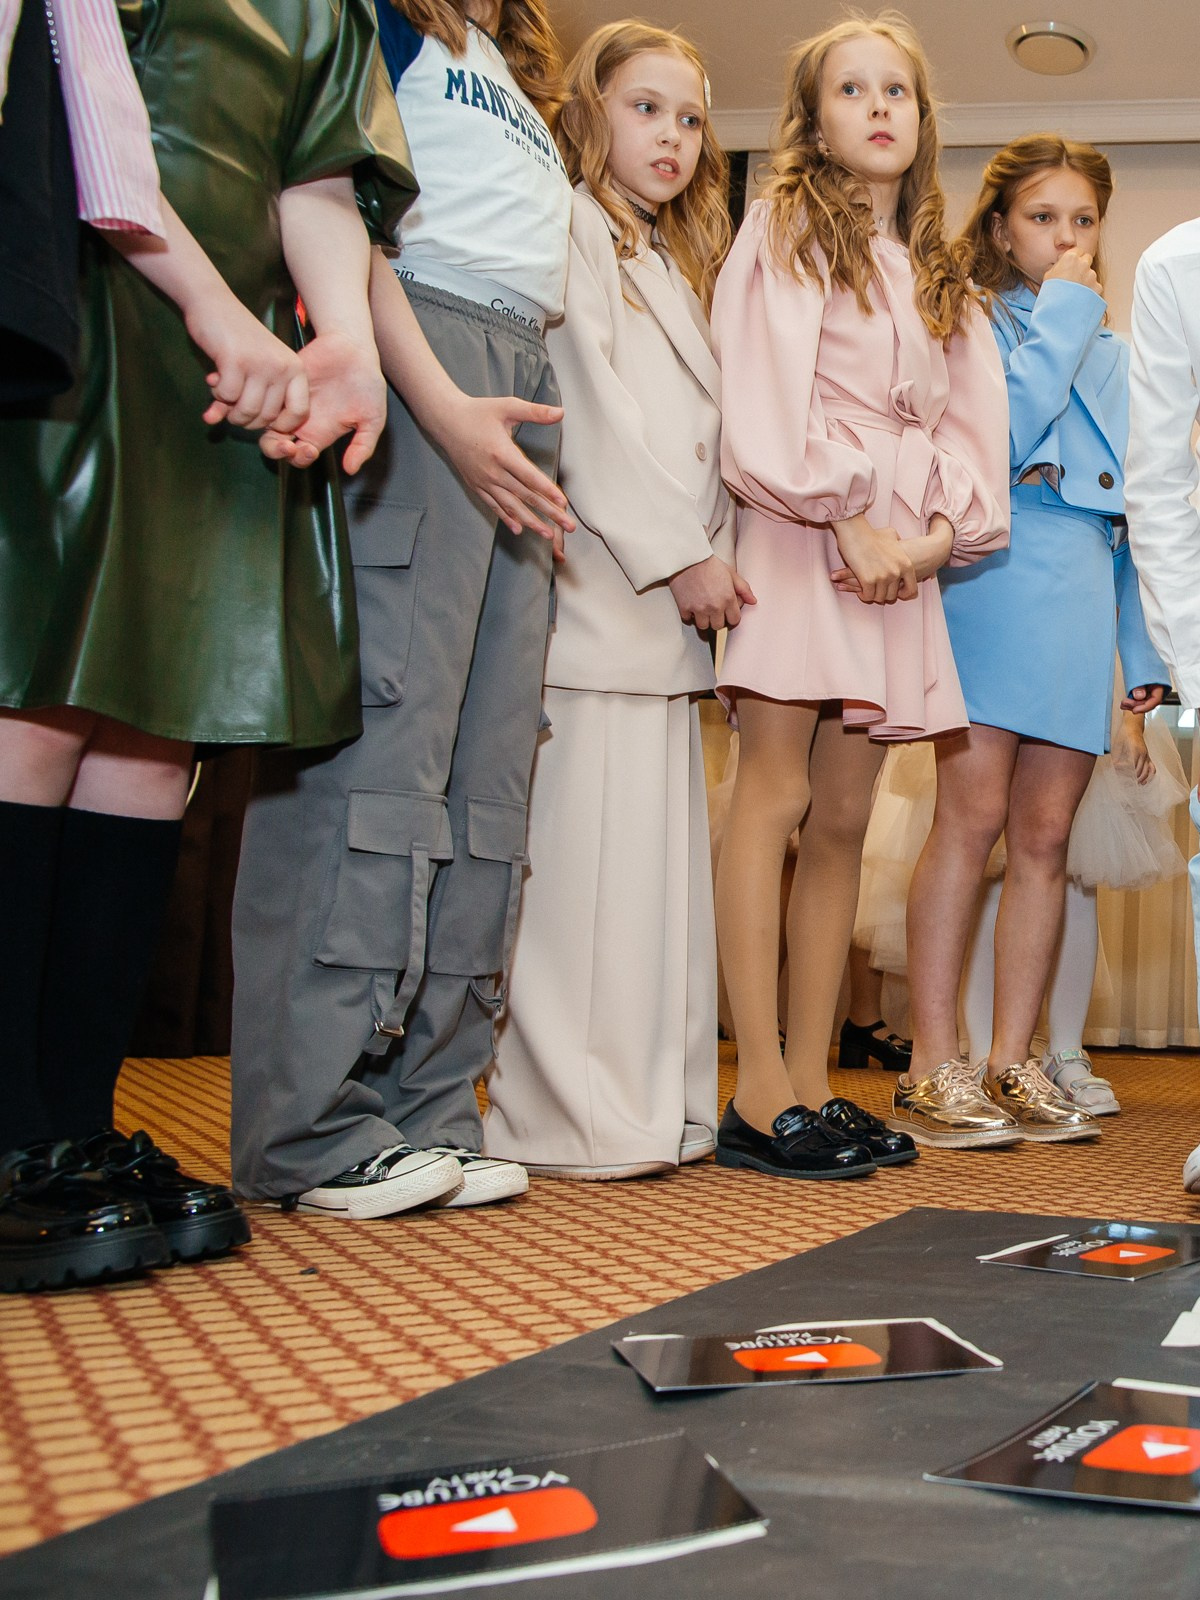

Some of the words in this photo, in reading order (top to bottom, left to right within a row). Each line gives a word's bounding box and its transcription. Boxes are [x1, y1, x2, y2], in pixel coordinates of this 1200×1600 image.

[504, 129, 531, 155] SINCE
[490, 298, 527, 325] Calvin
[724, 1334, 853, 1351] YOUTUBE
[377, 1470, 571, 1512] YOUTUBE
